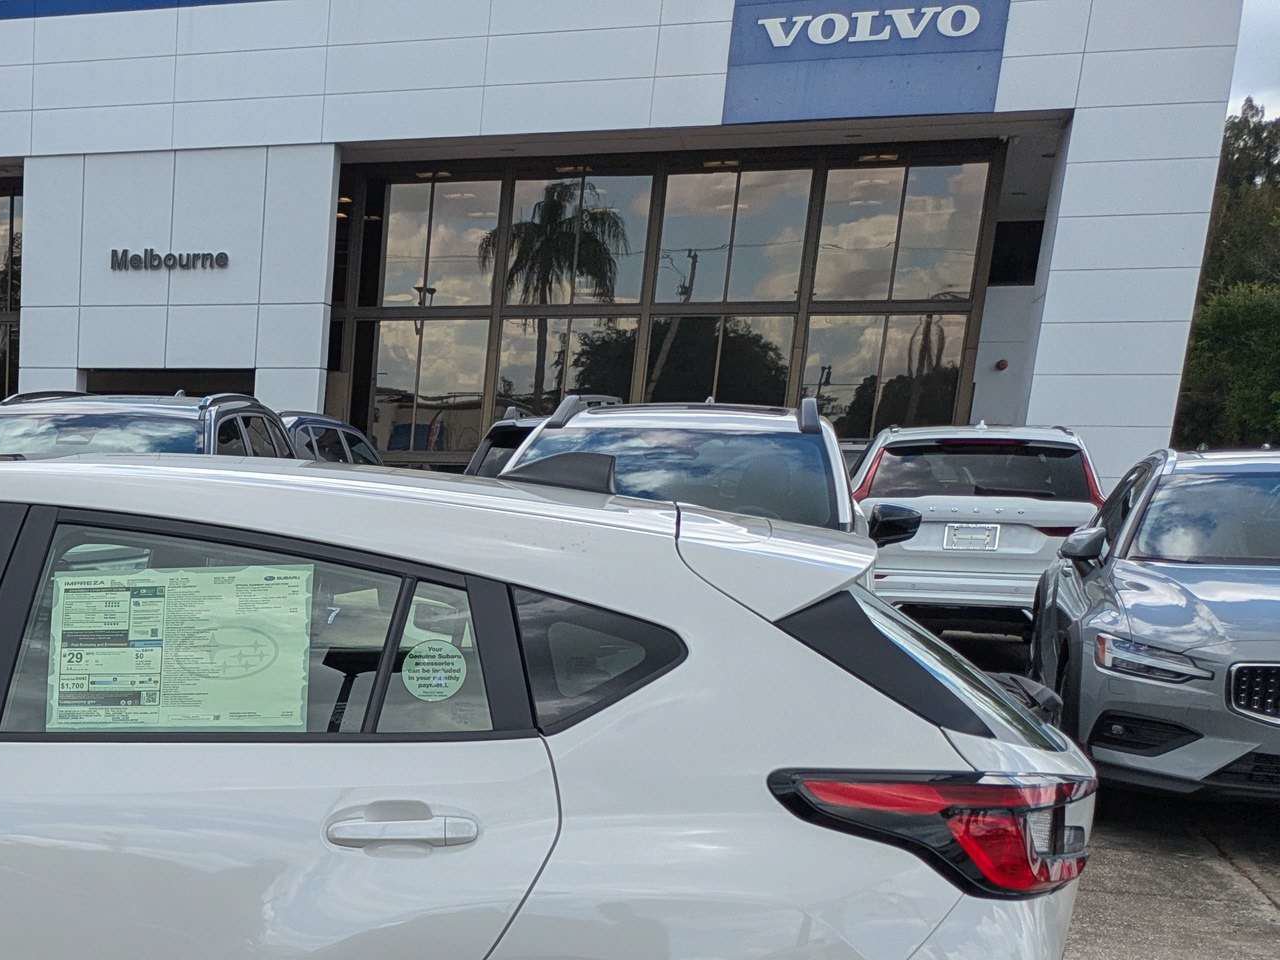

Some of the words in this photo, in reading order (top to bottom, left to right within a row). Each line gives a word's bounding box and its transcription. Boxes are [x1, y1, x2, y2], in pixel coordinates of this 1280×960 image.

[758, 4, 980, 48] VOLVO
[110, 248, 229, 271] Melbourne
[66, 652, 83, 664] 29
[61, 682, 85, 690] $1,700
